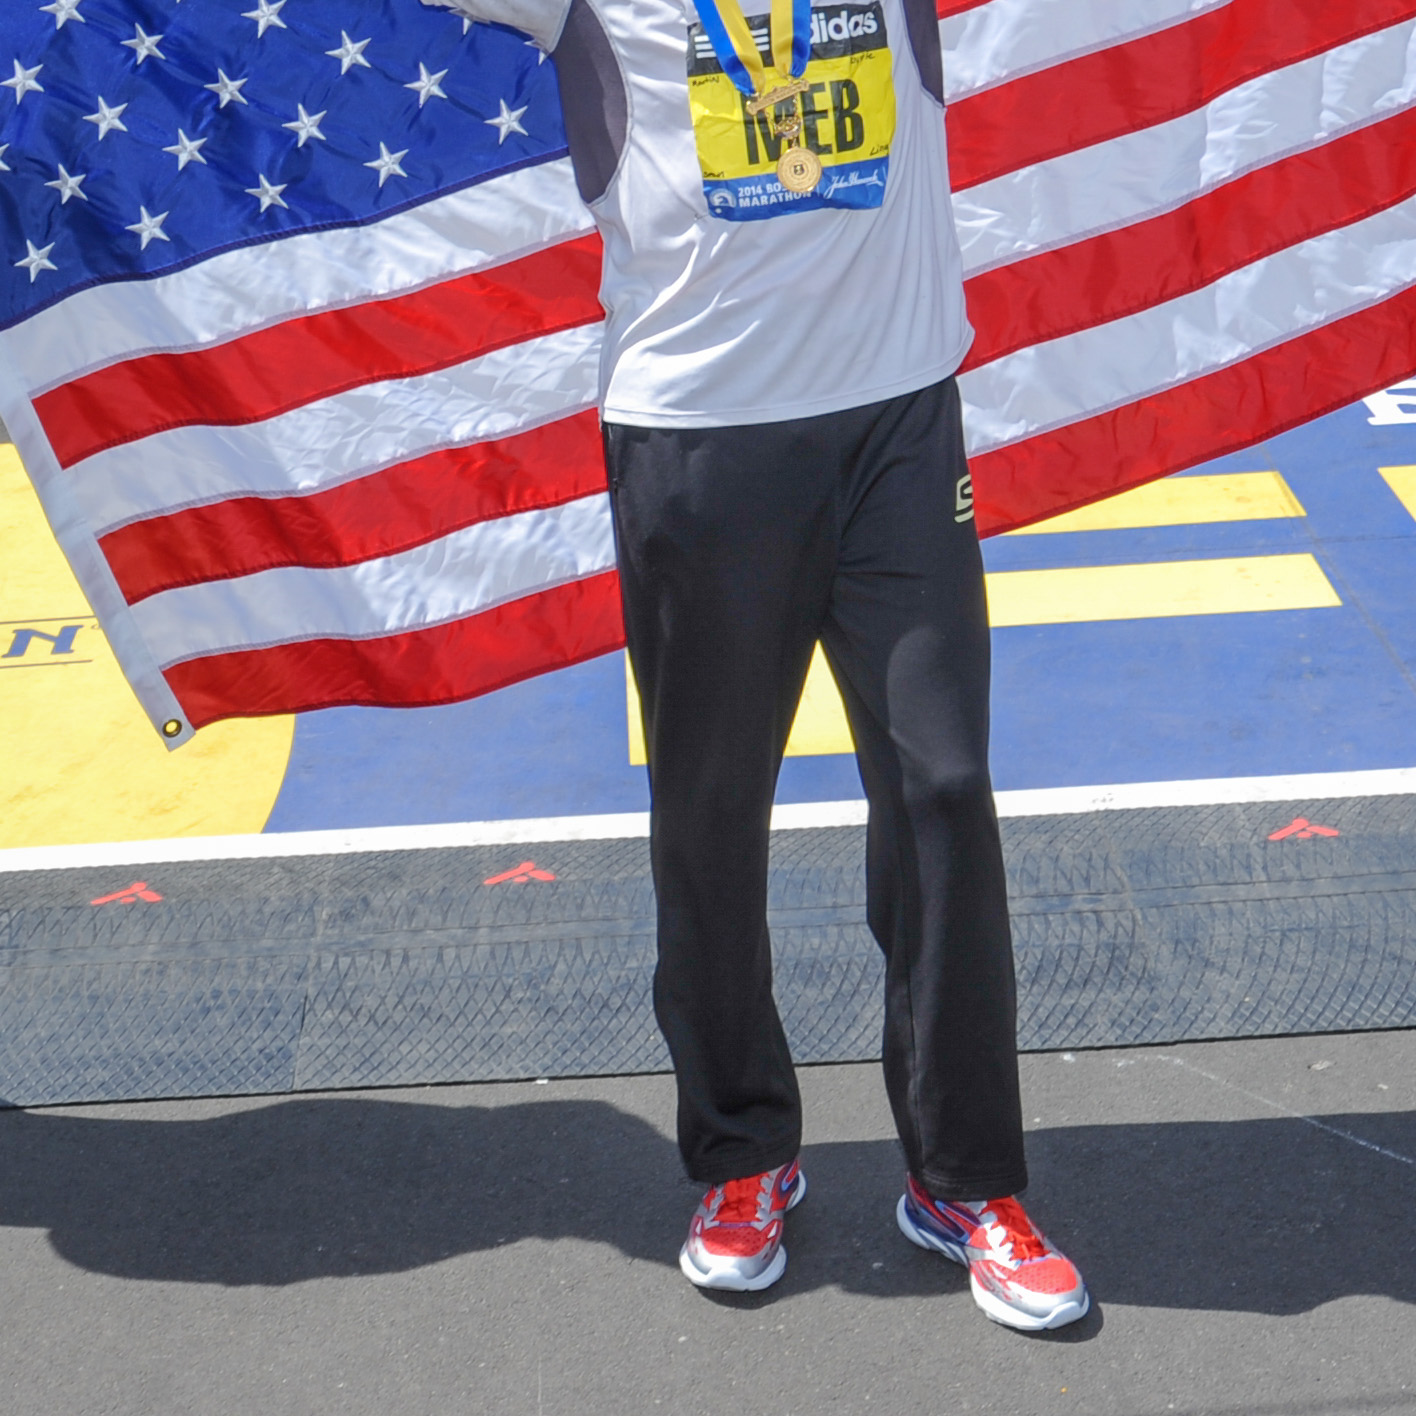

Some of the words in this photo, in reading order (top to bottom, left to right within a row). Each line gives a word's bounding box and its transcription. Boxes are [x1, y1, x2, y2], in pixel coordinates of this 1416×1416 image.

[809, 11, 879, 45] didas
[740, 78, 866, 166] MEB
[737, 183, 764, 197] 2014
